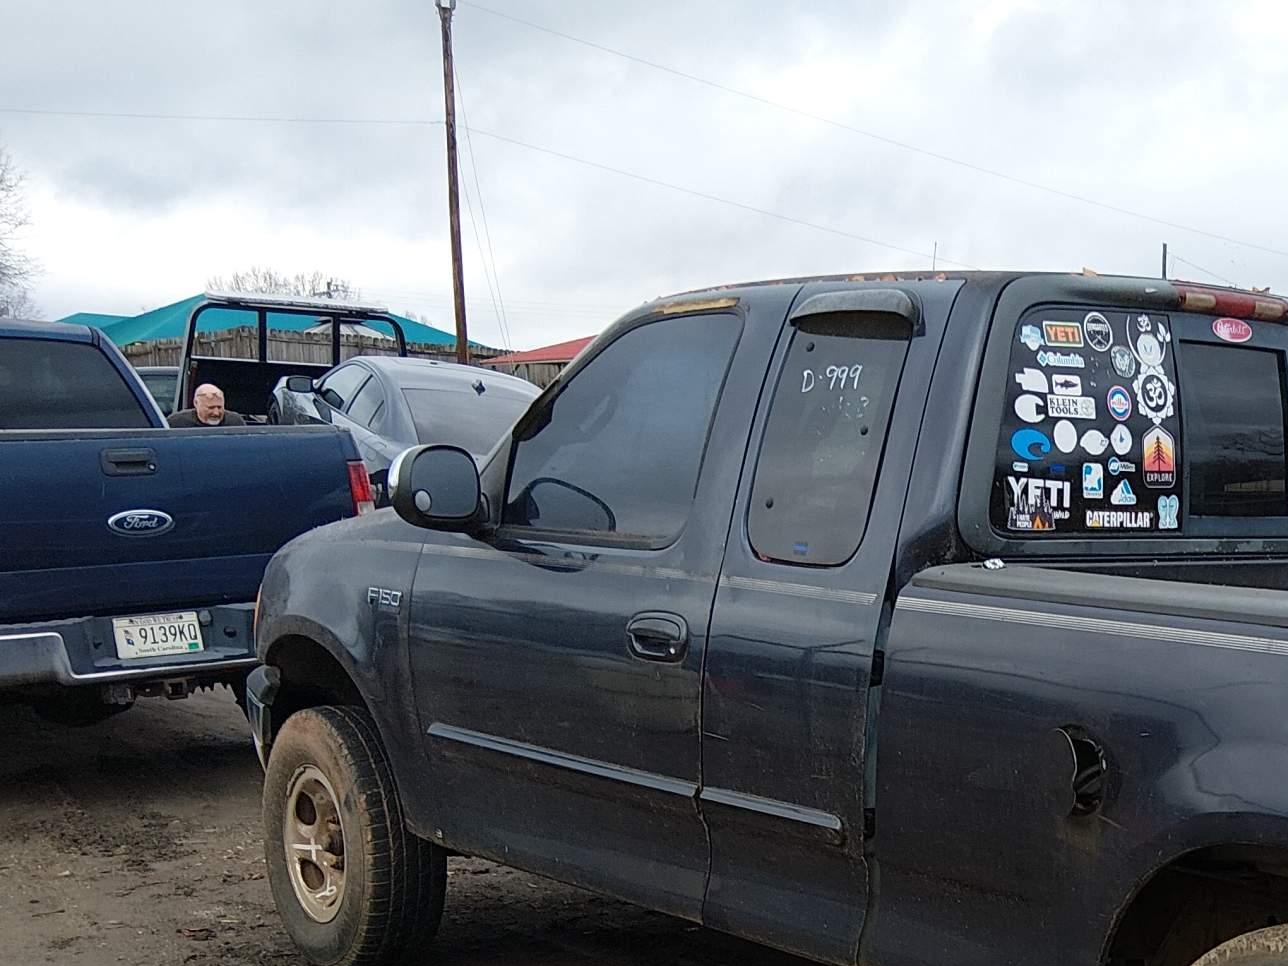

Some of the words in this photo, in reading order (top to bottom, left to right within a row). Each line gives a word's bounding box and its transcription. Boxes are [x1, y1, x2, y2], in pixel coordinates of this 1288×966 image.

[1046, 325, 1080, 343] YETI
[1049, 397, 1078, 407] KLEIN
[1050, 406, 1079, 416] TOOLS
[1146, 472, 1173, 483] EXPLORE
[1007, 476, 1071, 508] YETI
[123, 514, 159, 529] Ford
[1086, 511, 1151, 528] CATERPILLAR
[367, 586, 402, 607] F150
[138, 623, 198, 645] 9139KQ
